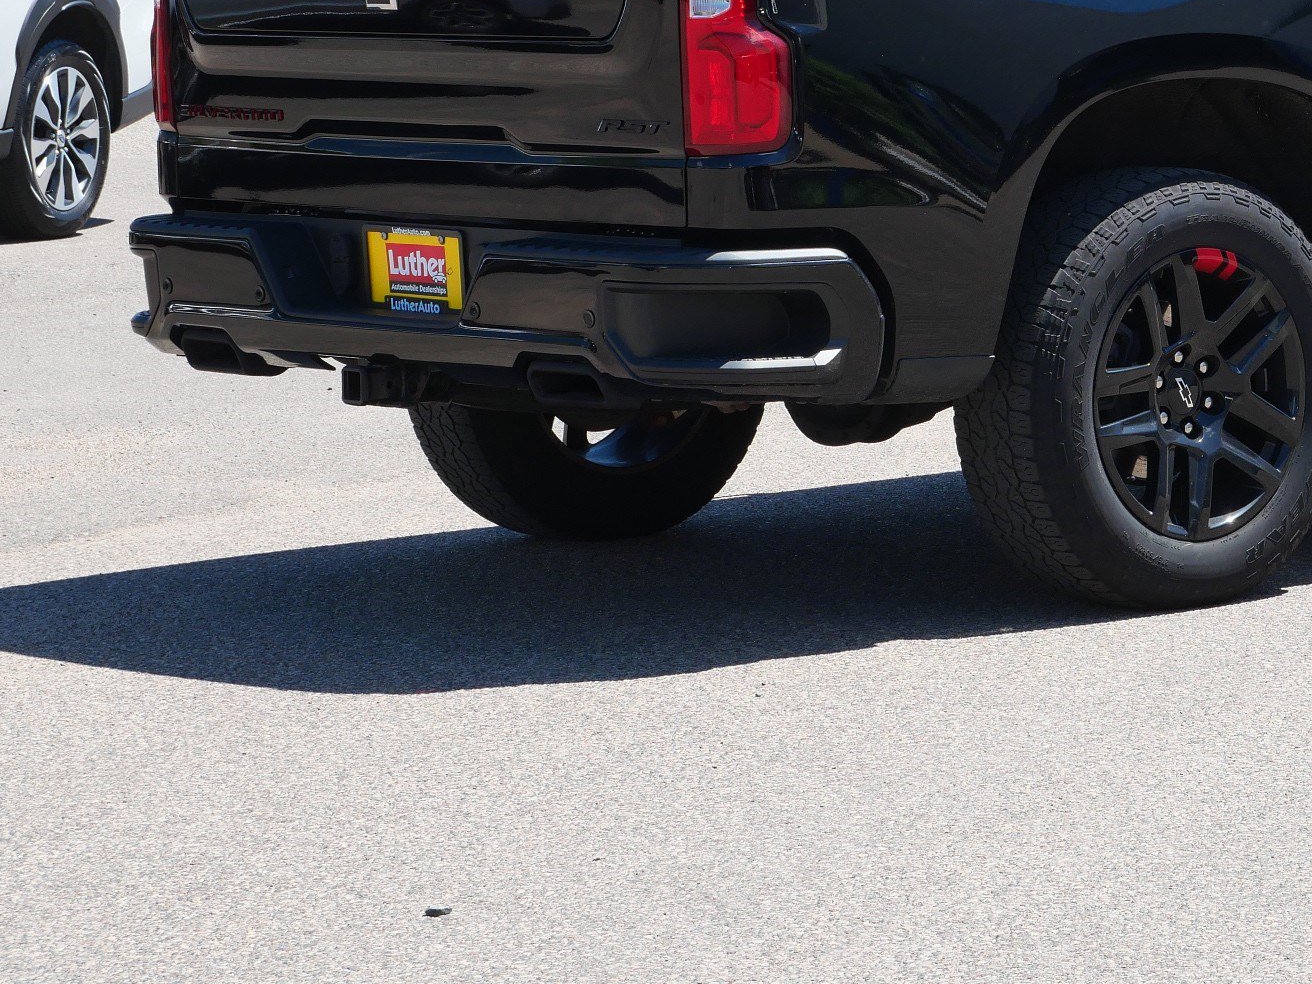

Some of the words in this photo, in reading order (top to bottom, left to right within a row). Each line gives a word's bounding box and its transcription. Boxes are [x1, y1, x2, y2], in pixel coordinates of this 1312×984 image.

[597, 118, 671, 134] RST
[387, 249, 445, 277] Luther
[391, 283, 419, 292] Automobile
[419, 284, 447, 295] Dealerships
[390, 297, 440, 314] LutherAuto
[1069, 222, 1167, 473] WRANGLER
